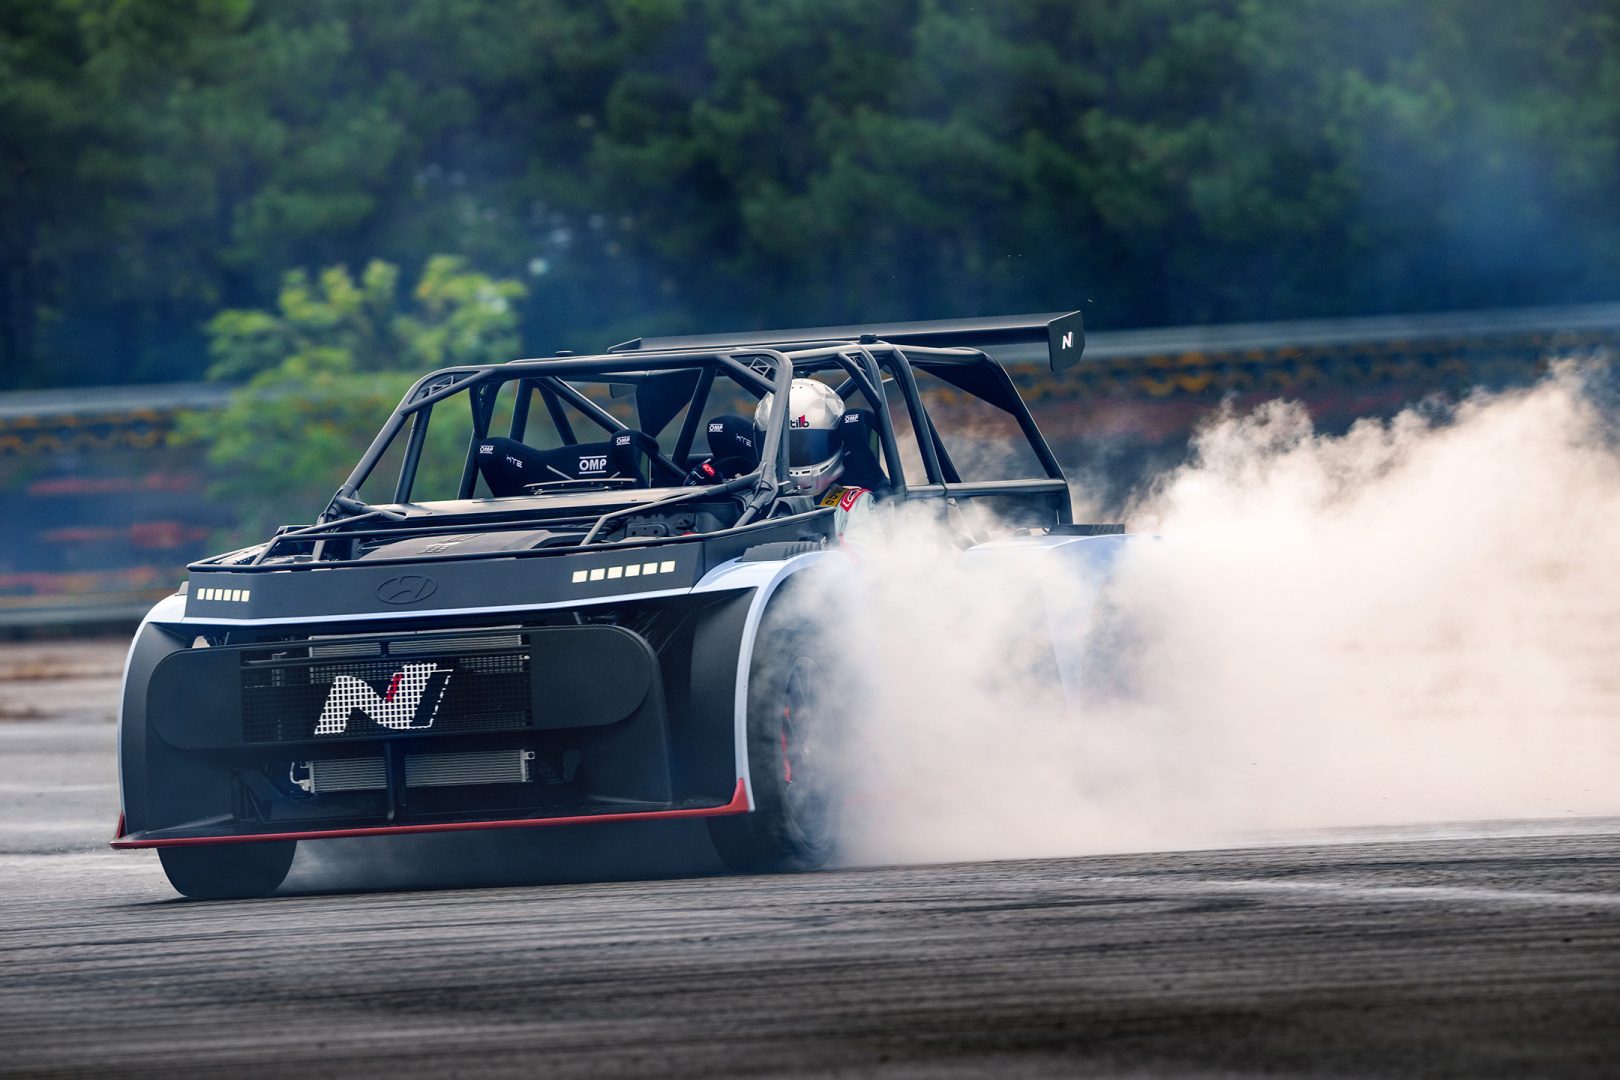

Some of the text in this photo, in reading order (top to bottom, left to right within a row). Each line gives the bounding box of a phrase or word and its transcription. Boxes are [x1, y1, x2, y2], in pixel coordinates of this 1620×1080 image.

[1062, 331, 1074, 350] N
[789, 414, 810, 429] tilo
[844, 414, 859, 423] OMP
[708, 423, 723, 432] OMP
[616, 436, 631, 445] OMP
[479, 445, 494, 454] OMP
[578, 458, 608, 471] OMP
[313, 662, 454, 735] N
